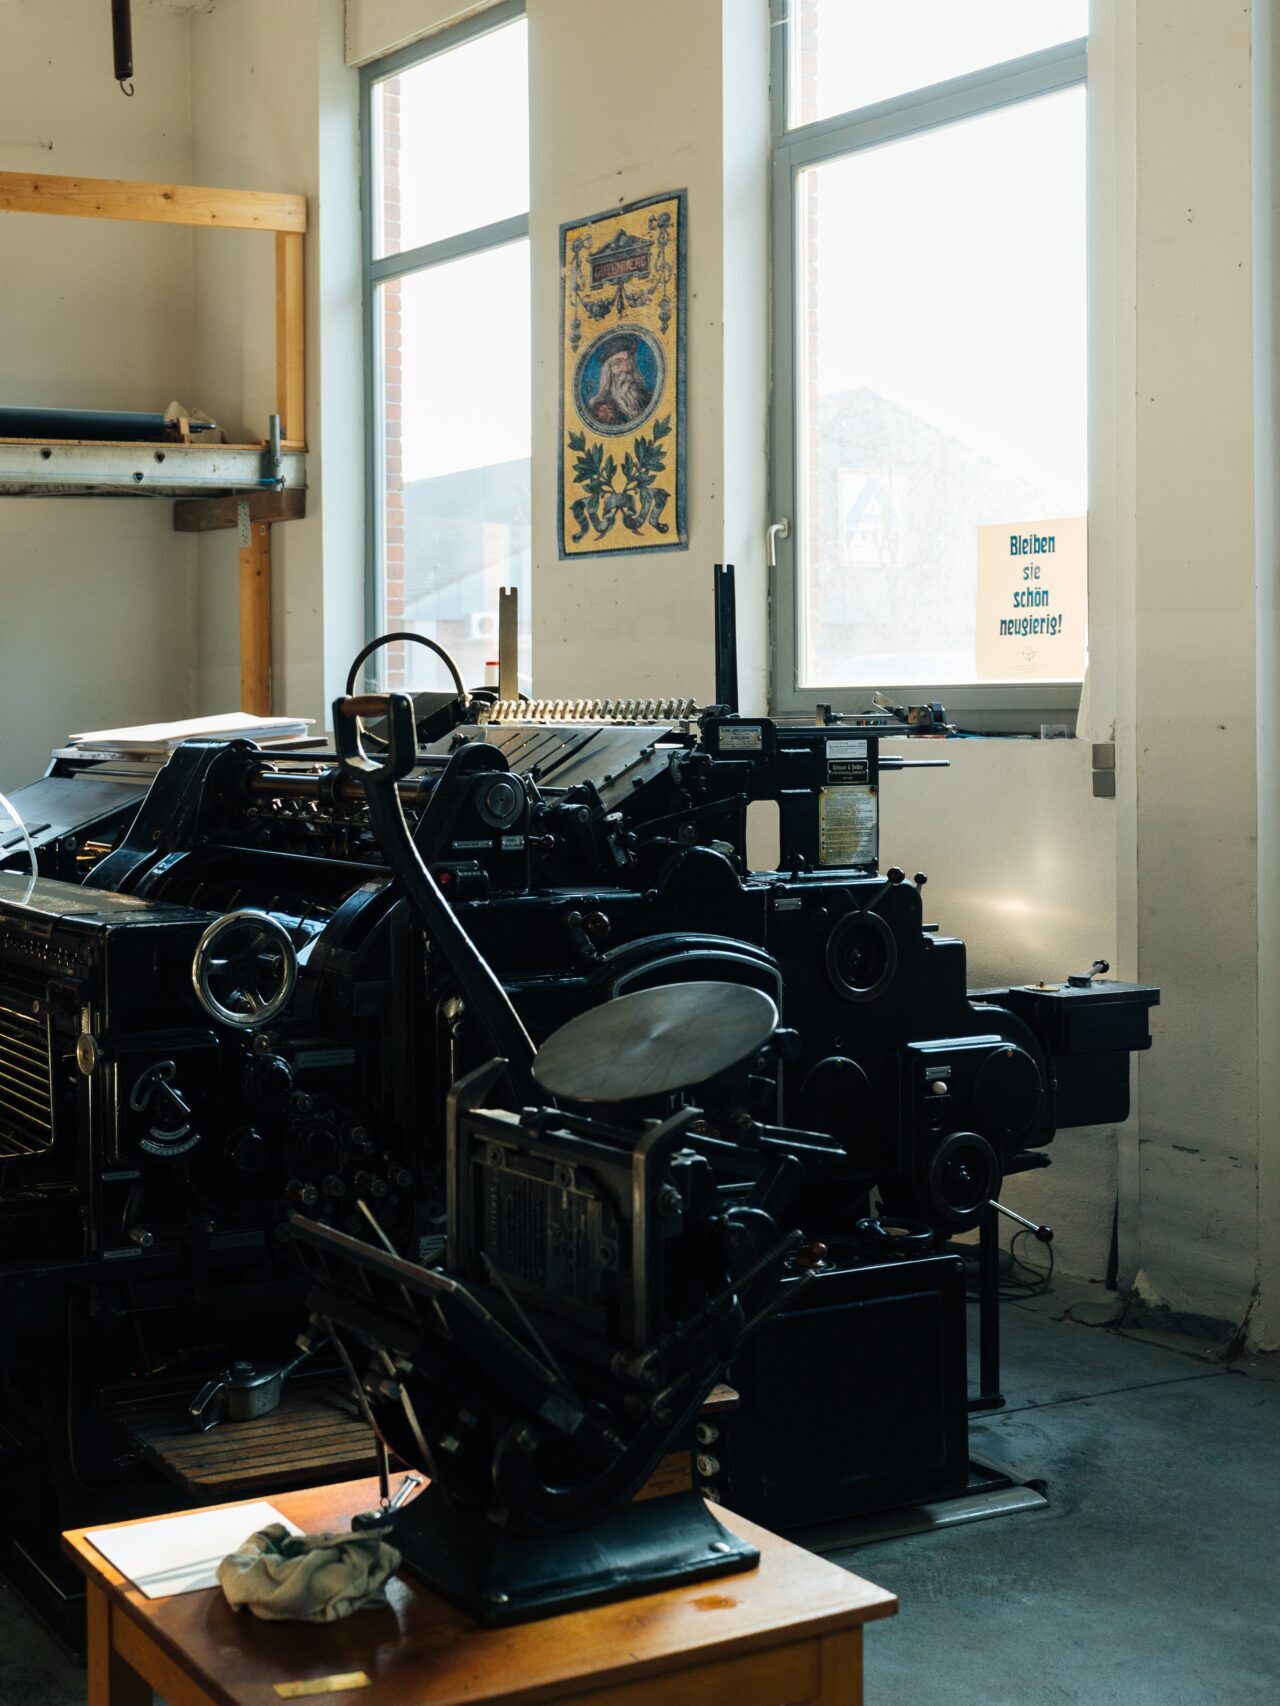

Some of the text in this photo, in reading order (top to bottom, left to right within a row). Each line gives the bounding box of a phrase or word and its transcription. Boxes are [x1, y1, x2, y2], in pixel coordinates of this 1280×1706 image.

[1010, 534, 1056, 555] Bleiben
[1023, 562, 1040, 580] sie
[1013, 587, 1049, 608] schön
[1000, 614, 1062, 636] neugierig!
